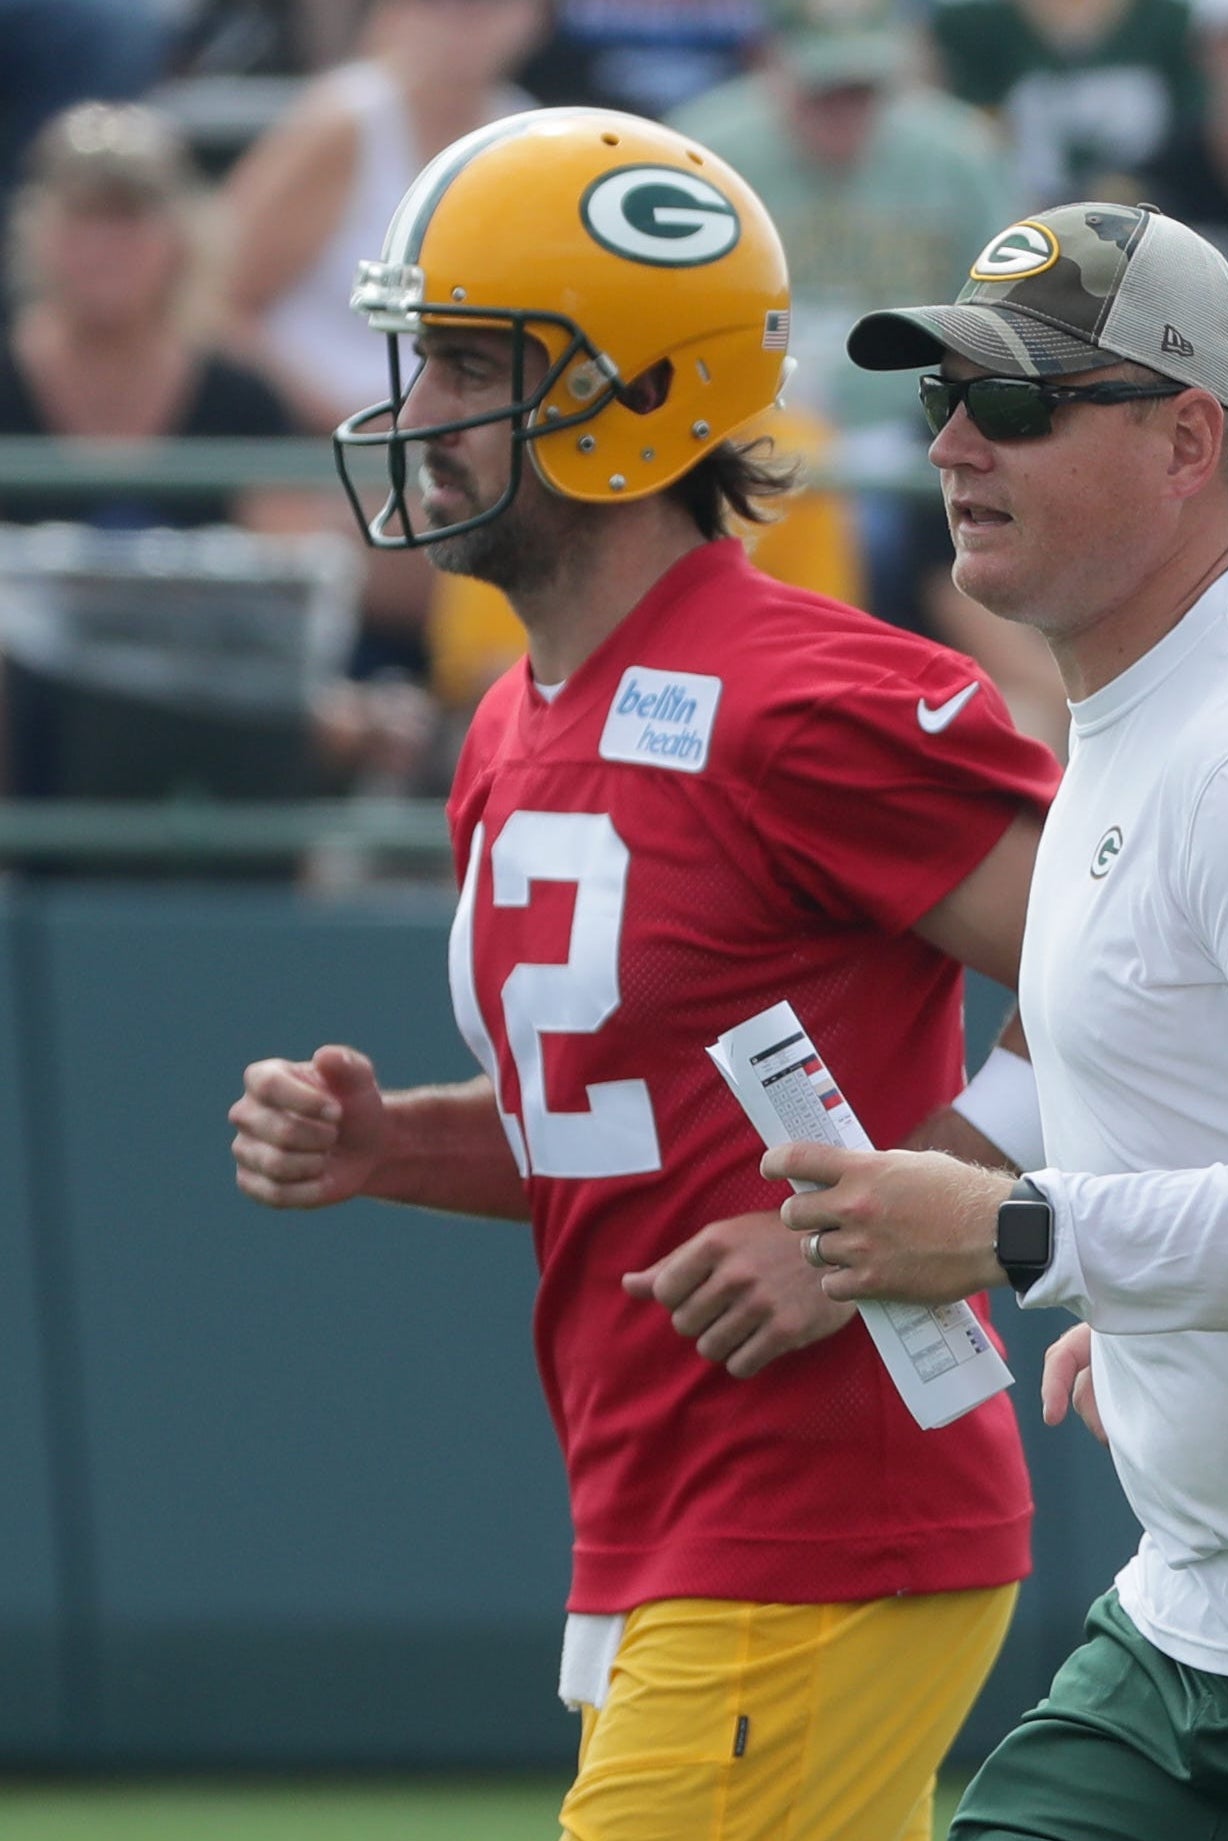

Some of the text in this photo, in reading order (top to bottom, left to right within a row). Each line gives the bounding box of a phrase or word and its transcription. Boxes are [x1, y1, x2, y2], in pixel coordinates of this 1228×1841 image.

[586, 167, 736, 260] G
[972, 224, 1051, 276] G
[616, 679, 697, 724] bellin
[636, 726, 705, 760] health
[448, 809, 662, 1179] 12
